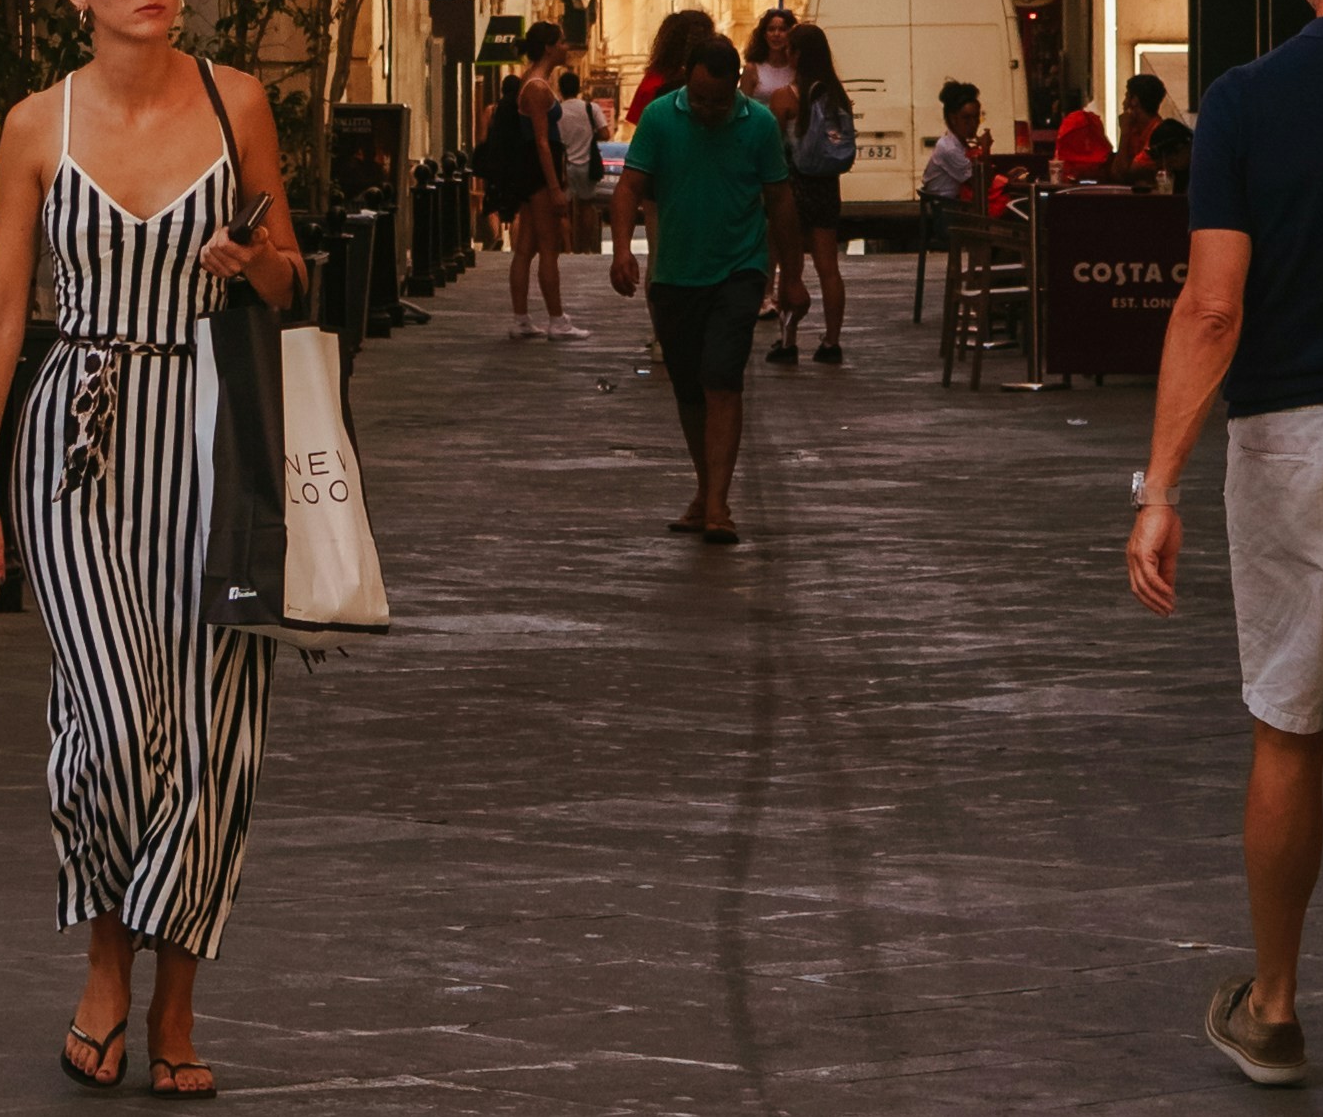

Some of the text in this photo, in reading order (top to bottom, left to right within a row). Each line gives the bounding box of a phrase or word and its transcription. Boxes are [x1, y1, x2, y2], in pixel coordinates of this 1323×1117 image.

[868, 147, 892, 158] 632
[1073, 262, 1163, 286] COSTA
[1111, 297, 1138, 309] EST.
[287, 480, 349, 504] LOO
